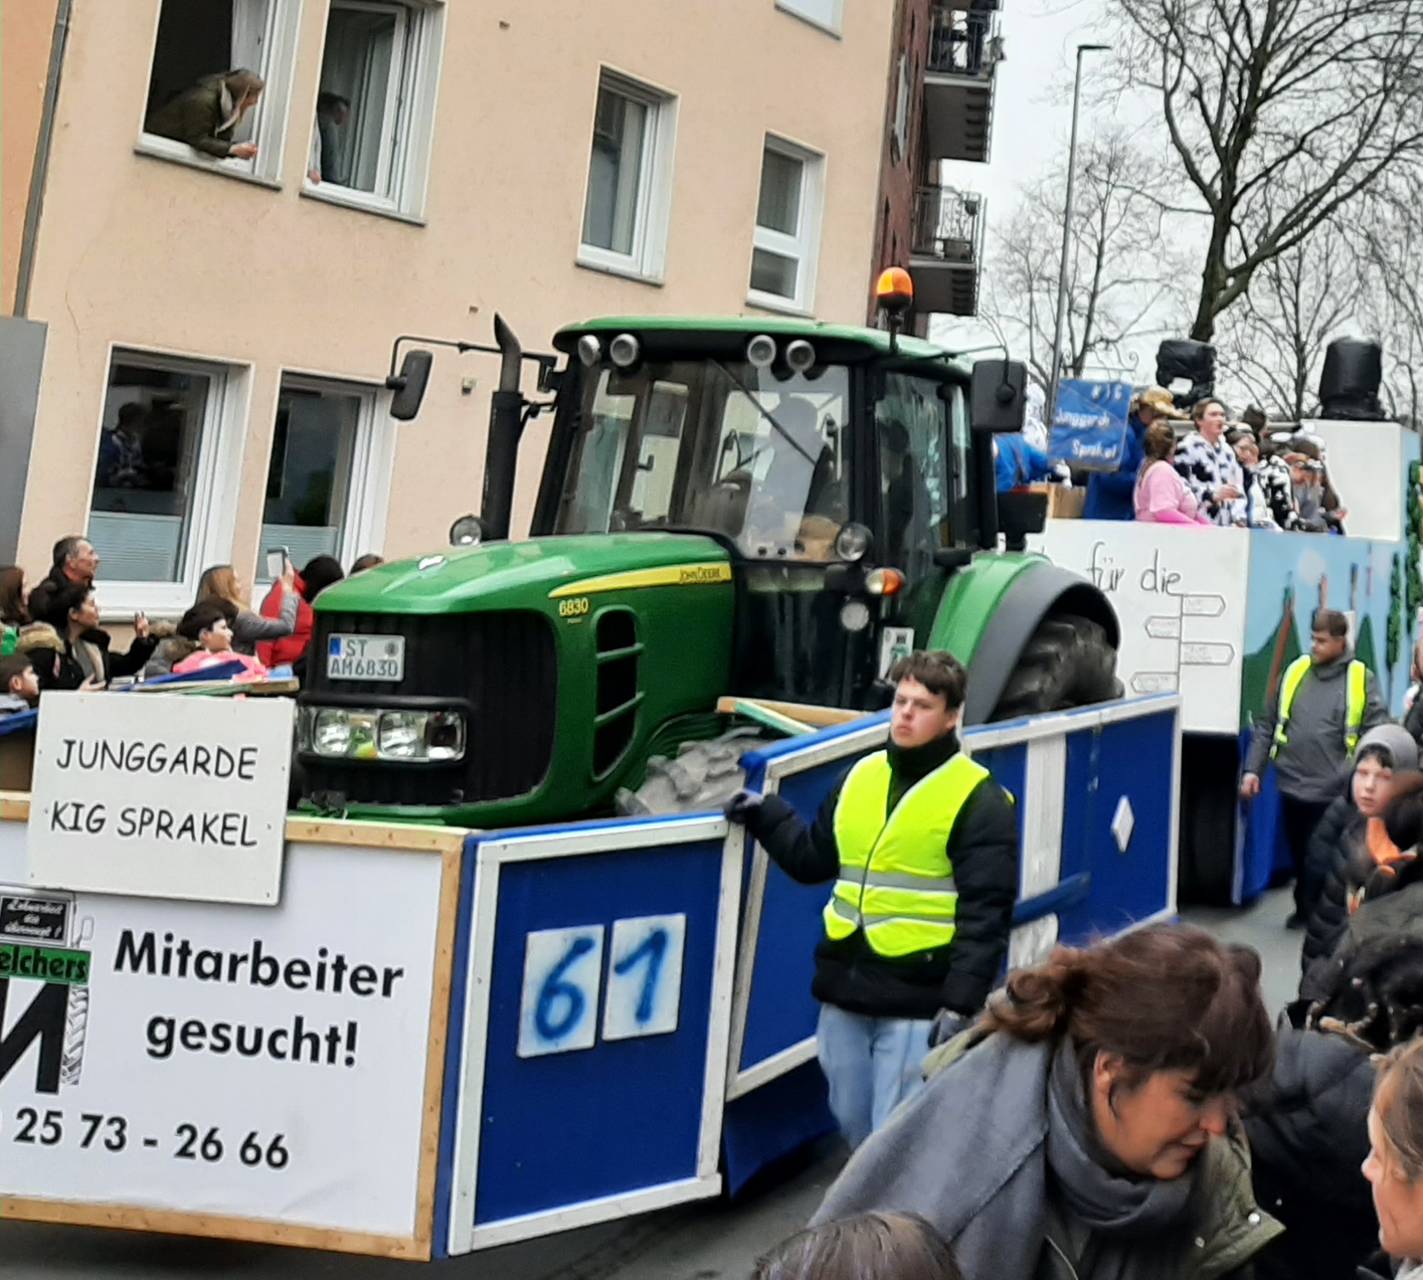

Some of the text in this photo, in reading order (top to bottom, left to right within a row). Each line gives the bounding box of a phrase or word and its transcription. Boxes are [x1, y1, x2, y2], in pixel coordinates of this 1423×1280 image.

[1086, 541, 1182, 597] für die
[559, 597, 589, 617] 6830
[346, 639, 368, 657] ST
[57, 739, 258, 780] JUNGGARDE
[51, 801, 258, 847] KIG SPRAKEL
[113, 929, 404, 998] Mitarbeiter
[535, 928, 669, 1041] 61
[146, 1014, 358, 1068] gesucht!
[13, 1107, 63, 1146] 25
[80, 1113, 128, 1152] 73
[174, 1123, 223, 1163] 26
[239, 1131, 289, 1169] 66
